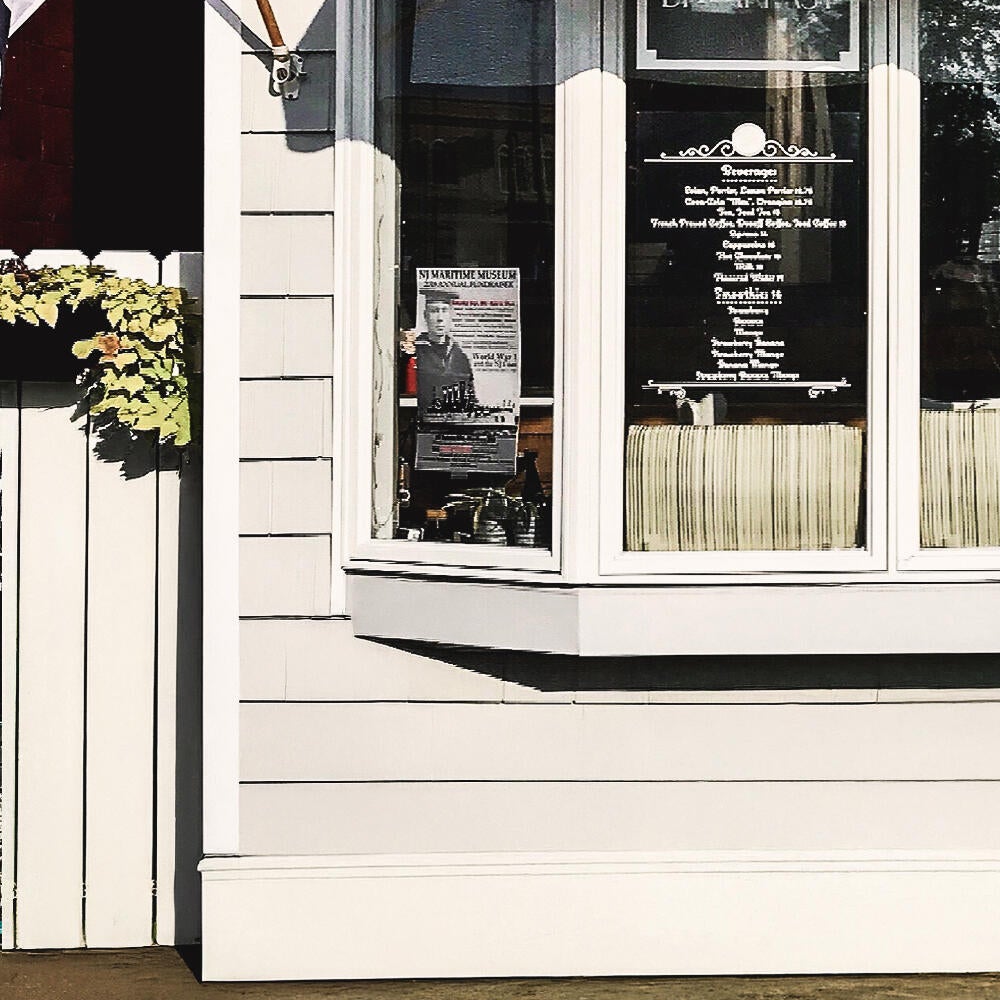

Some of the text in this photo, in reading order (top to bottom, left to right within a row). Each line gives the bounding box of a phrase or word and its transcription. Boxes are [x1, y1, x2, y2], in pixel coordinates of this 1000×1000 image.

[721, 164, 777, 178] Beverages
[432, 270, 476, 280] MARITIME
[478, 270, 517, 280] MUSEUM
